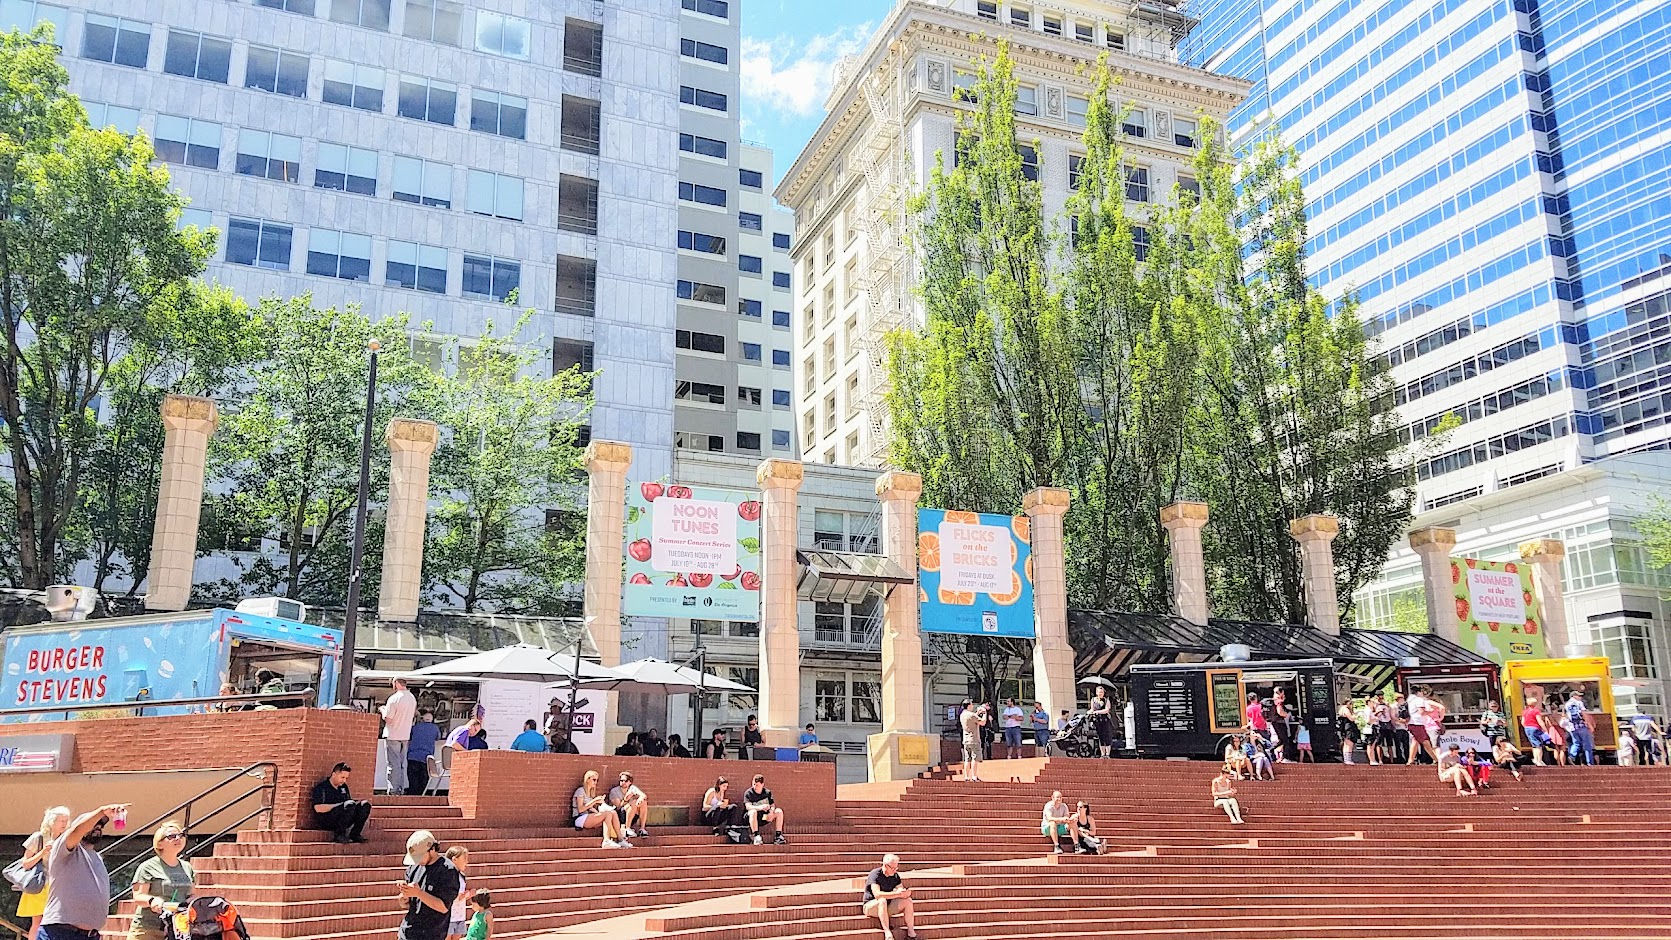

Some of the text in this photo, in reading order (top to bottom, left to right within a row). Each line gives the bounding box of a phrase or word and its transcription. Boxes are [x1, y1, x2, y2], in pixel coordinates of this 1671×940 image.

[673, 504, 719, 520] NOON
[671, 519, 719, 535] TUNES
[953, 528, 995, 542] FLICKS
[658, 537, 731, 548] Summer Concert Series
[974, 543, 988, 552] the
[668, 549, 694, 559] TUESDAYS
[952, 552, 998, 567] BRICKS
[671, 559, 684, 567] JULY
[696, 561, 708, 569] AUG
[958, 571, 995, 580] FRIDAYS AT DUSK
[1473, 573, 1515, 588] SUMMER
[980, 581, 990, 589] AUG
[1495, 586, 1506, 595] the
[1478, 595, 1517, 609] SQUARE
[27, 645, 105, 673] BURGER
[16, 674, 107, 704] STEVENS
[1460, 735, 1481, 745] Bowl
